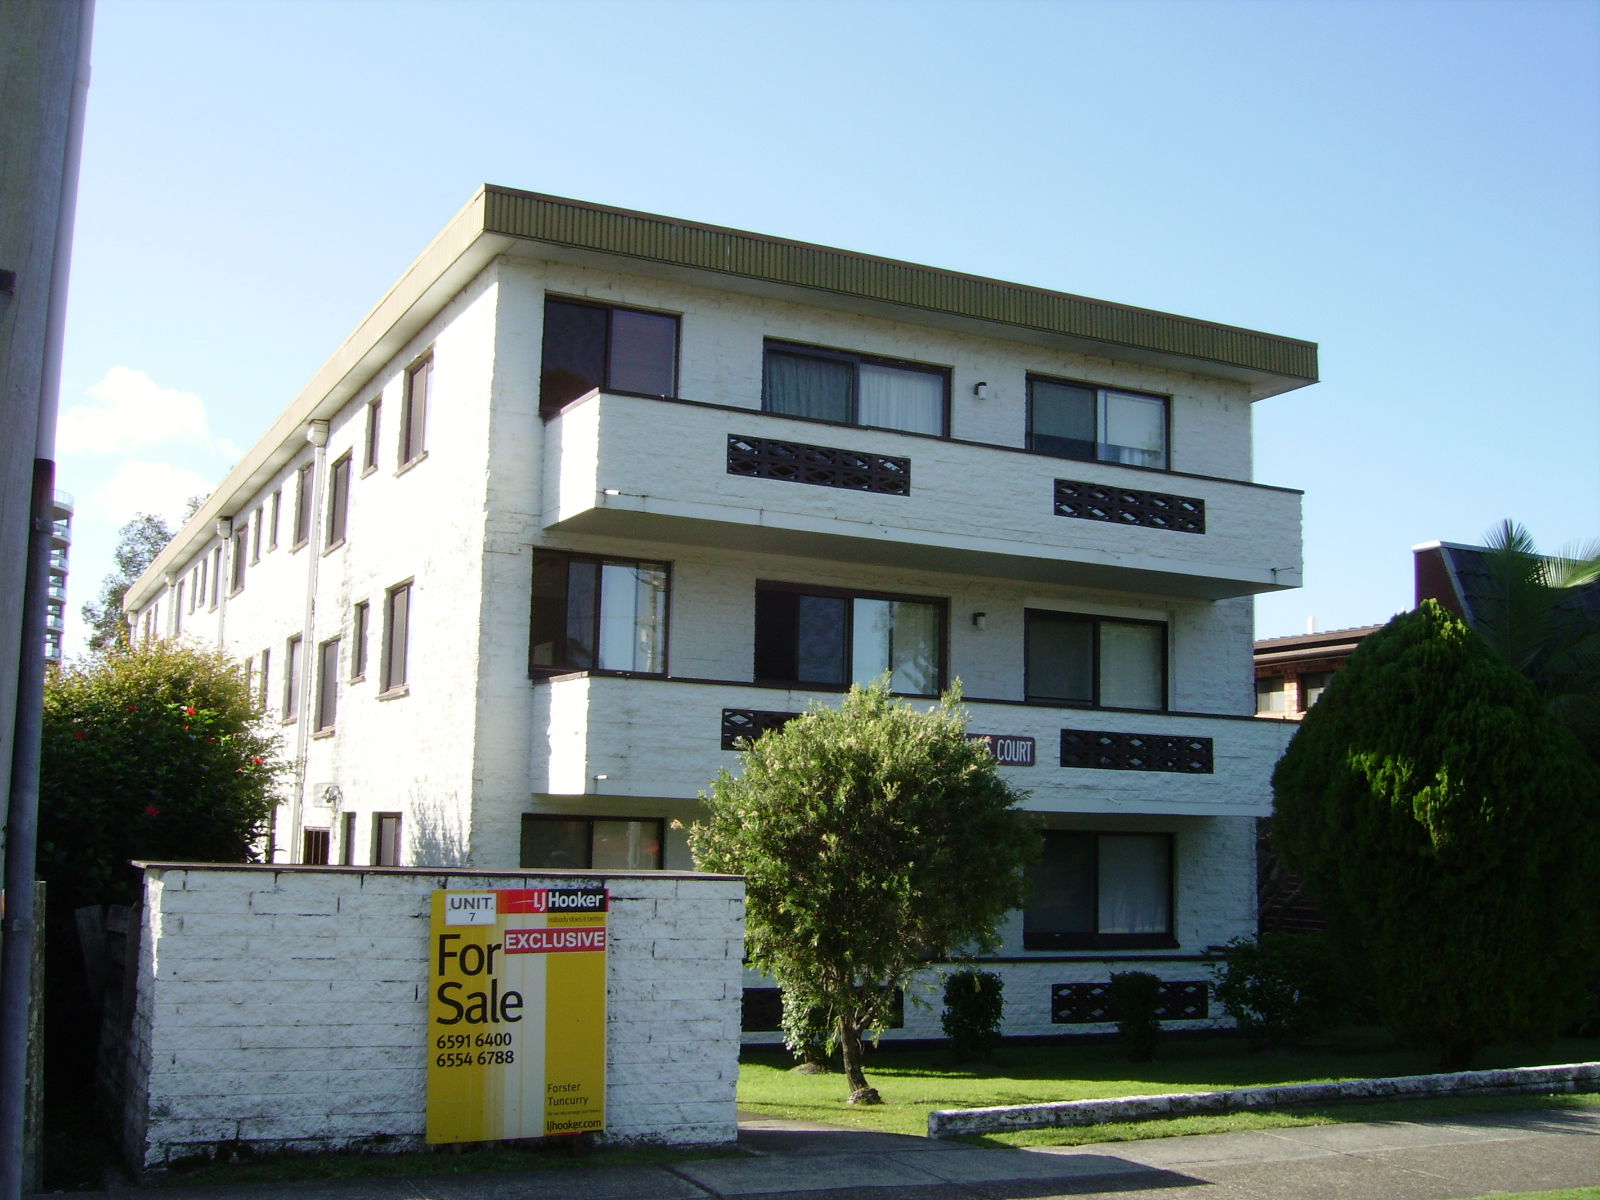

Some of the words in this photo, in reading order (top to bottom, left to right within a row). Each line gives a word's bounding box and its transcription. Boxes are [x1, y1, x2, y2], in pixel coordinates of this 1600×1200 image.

[997, 739, 1032, 762] COURT
[450, 897, 492, 910] UNIT
[470, 912, 476, 922] 7
[505, 931, 604, 950] EXCLUSIVE
[438, 933, 502, 976] For
[436, 978, 523, 1025] Sale
[437, 1034, 471, 1049] 6591
[475, 1033, 512, 1047] 6400
[436, 1052, 473, 1067] 6554
[477, 1050, 514, 1065] 6788
[547, 1083, 581, 1093] Forster
[548, 1096, 589, 1106] Tuncurry
[546, 1119, 602, 1132] ljhooker.com
